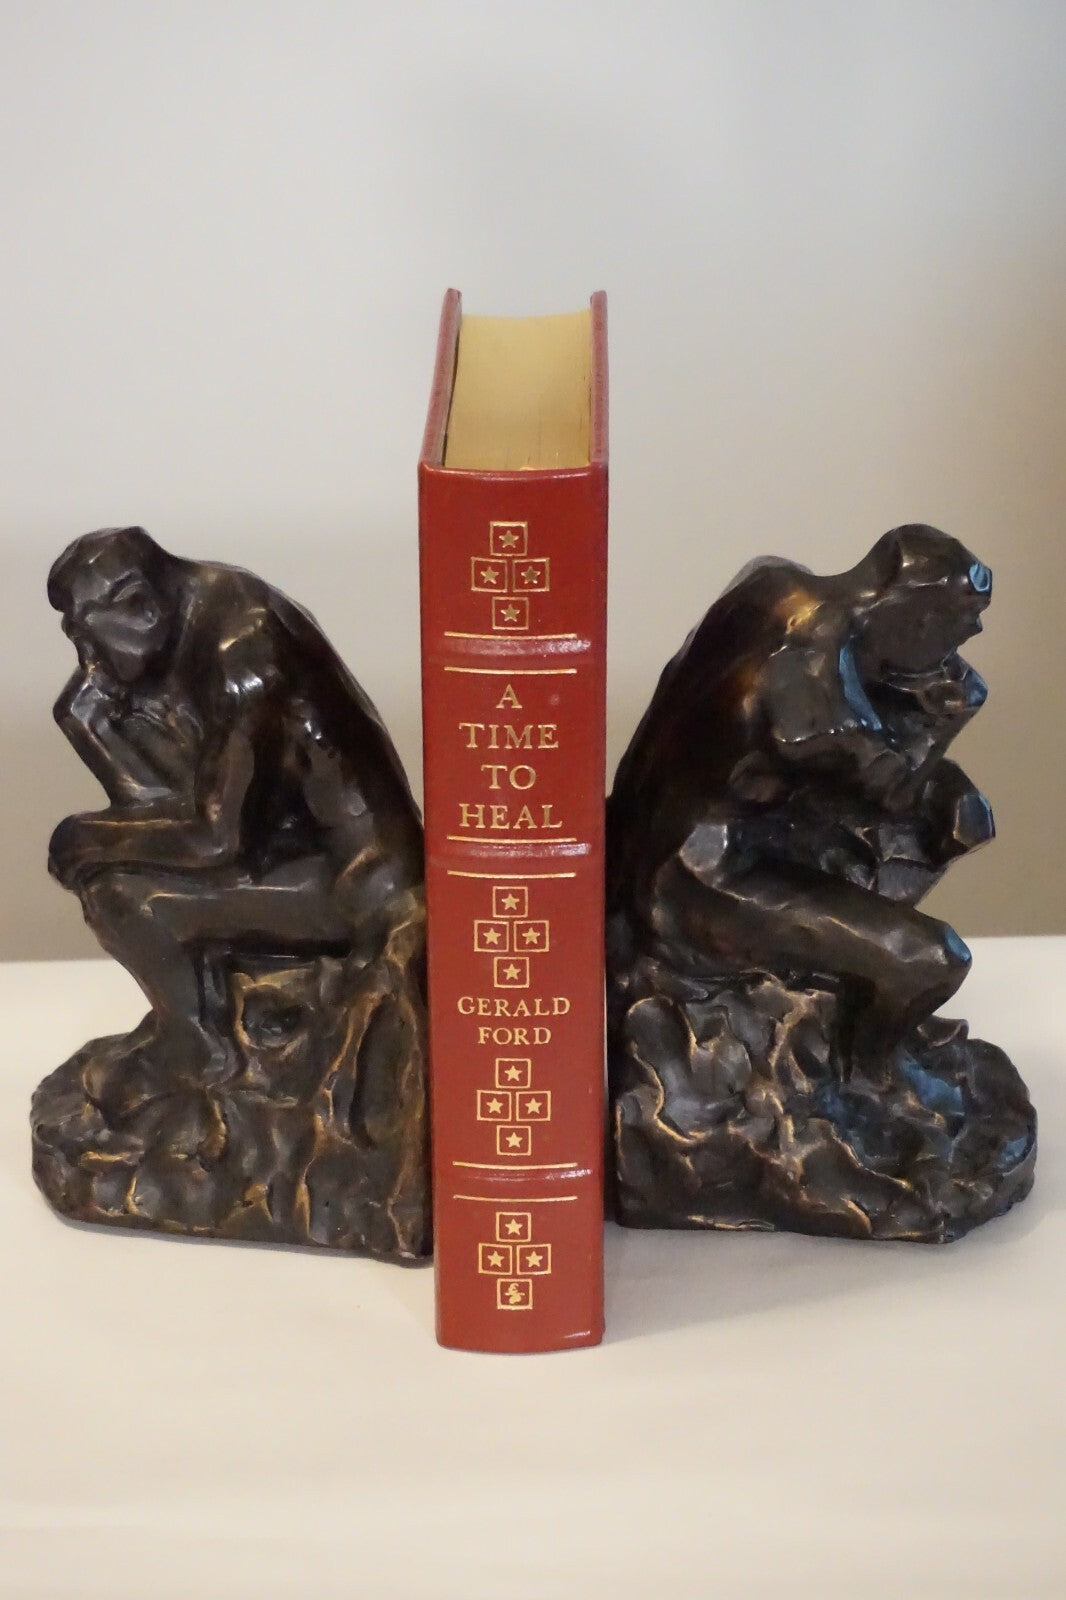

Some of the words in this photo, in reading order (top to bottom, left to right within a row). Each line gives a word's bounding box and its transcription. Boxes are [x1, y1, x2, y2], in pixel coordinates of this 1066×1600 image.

[495, 684, 523, 709] A
[458, 722, 559, 749] TIME
[480, 764, 537, 790] TO
[458, 803, 563, 830] HEAL
[457, 996, 571, 1017] GERALD
[477, 1026, 552, 1046] FORD
